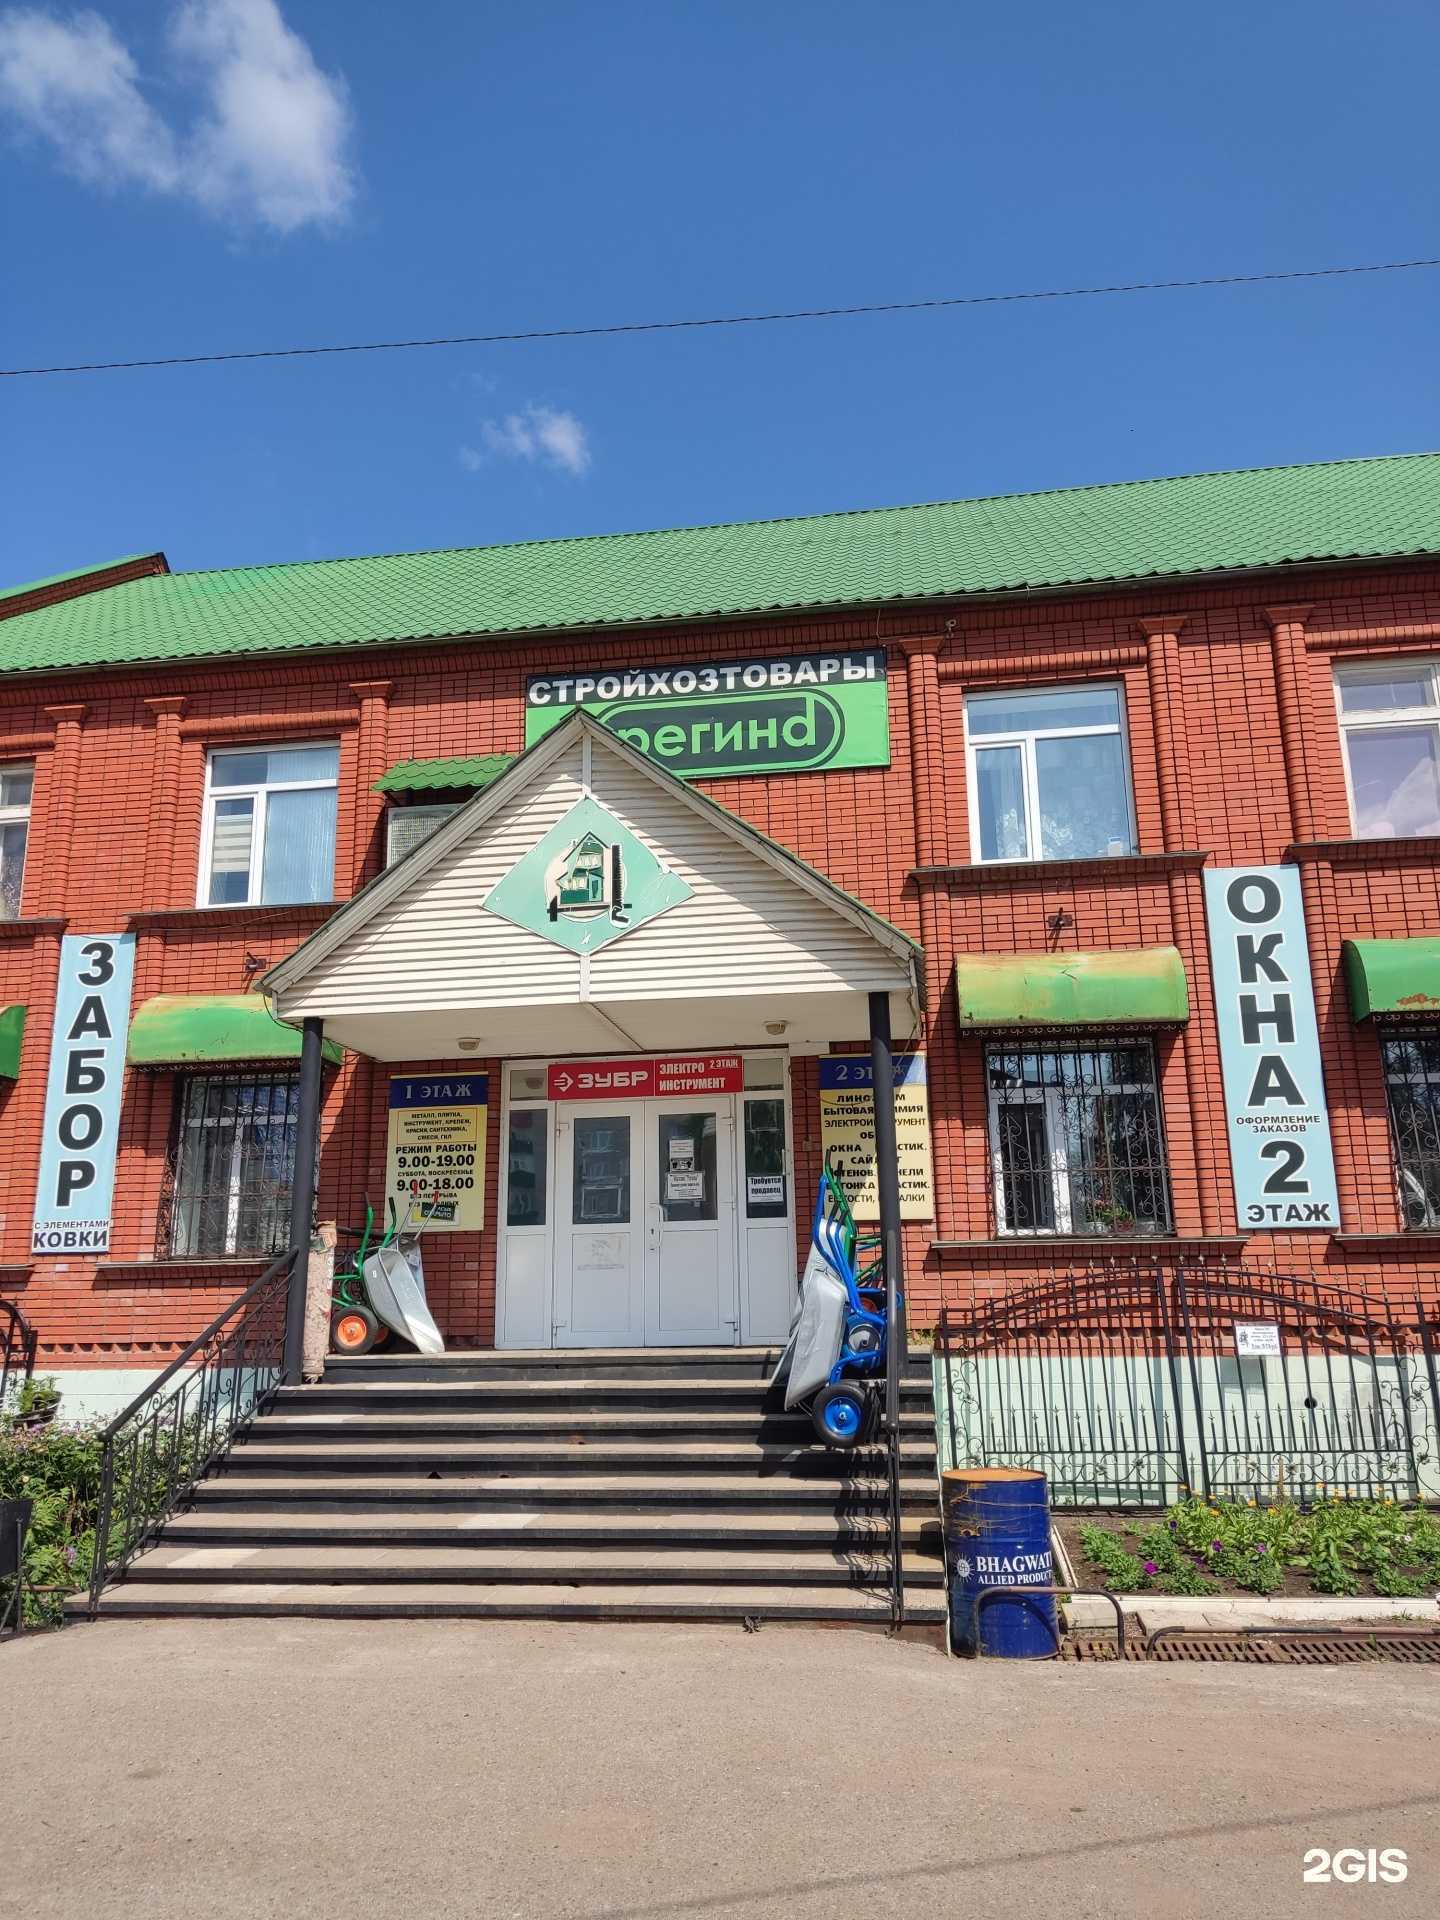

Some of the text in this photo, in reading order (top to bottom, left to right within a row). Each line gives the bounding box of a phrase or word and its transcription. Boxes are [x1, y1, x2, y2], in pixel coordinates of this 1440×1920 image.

[529, 654, 875, 704] СТРОЙХОЗТОВАРЫ
[1227, 874, 1306, 1107] ОКНА
[56, 942, 114, 1207] ЗАБОР
[660, 1063, 704, 1075] ЭЛЕКТРО
[836, 1064, 848, 1080] 2
[578, 1071, 648, 1088] ЗУБР
[660, 1078, 725, 1091] ИНСТРУМЕНТ
[421, 1084, 472, 1098] ЭТАЖ
[824, 1107, 874, 1115] БЫТОВАЯ
[1236, 1115, 1321, 1125] ОФОРМЛЕНИЕ
[1252, 1124, 1306, 1133] ЗАКАЗОВ
[396, 1143, 477, 1154] РЕЖИМ РАБОТЫ
[830, 1144, 862, 1152] ОКНА
[398, 1154, 475, 1168] 9.00-19.00
[1261, 1140, 1309, 1193] 2
[396, 1177, 475, 1191] 9.00-18.00
[1247, 1204, 1331, 1222] ЭТАЖ
[44, 1221, 109, 1229] ЭЛЕМЕНТАМИ
[33, 1231, 107, 1248] КОВКИ
[978, 1575, 1014, 1585] ALLIED
